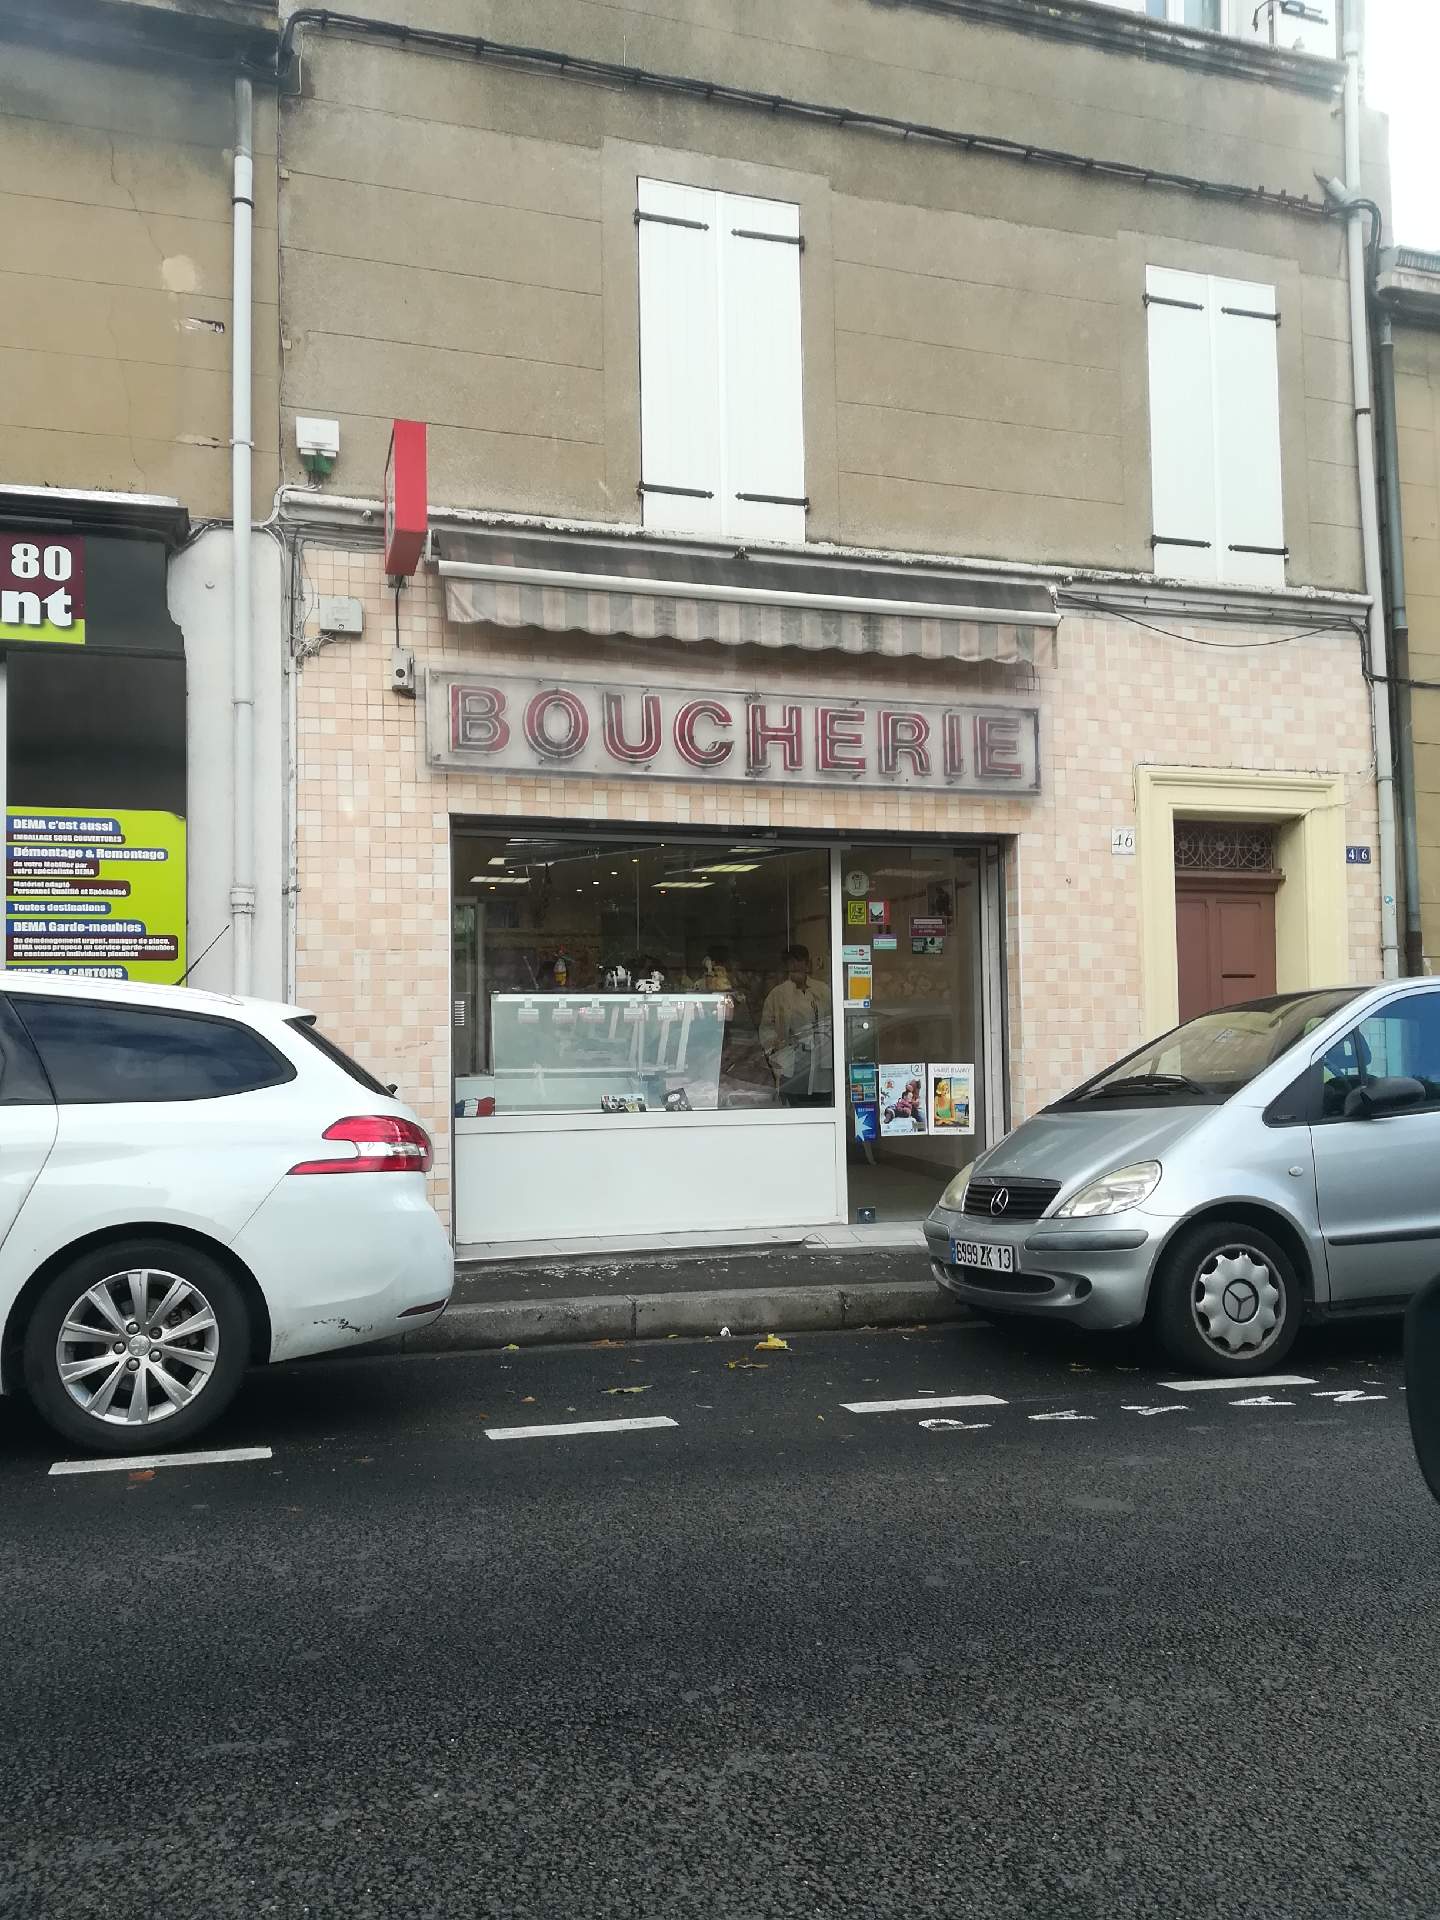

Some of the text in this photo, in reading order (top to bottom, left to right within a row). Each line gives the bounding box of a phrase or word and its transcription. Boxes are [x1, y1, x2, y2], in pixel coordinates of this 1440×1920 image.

[11, 543, 72, 581] 80
[448, 683, 1024, 778] BOUCHERIE
[14, 819, 112, 831] DEMA c'est aussi
[13, 847, 164, 859] Démontage & Remontage
[1348, 848, 1368, 860] 46
[14, 922, 141, 932] DEMA Garde-meubles
[69, 968, 123, 977] CARTONS
[956, 1242, 1011, 1269] 6999 ZK 13
